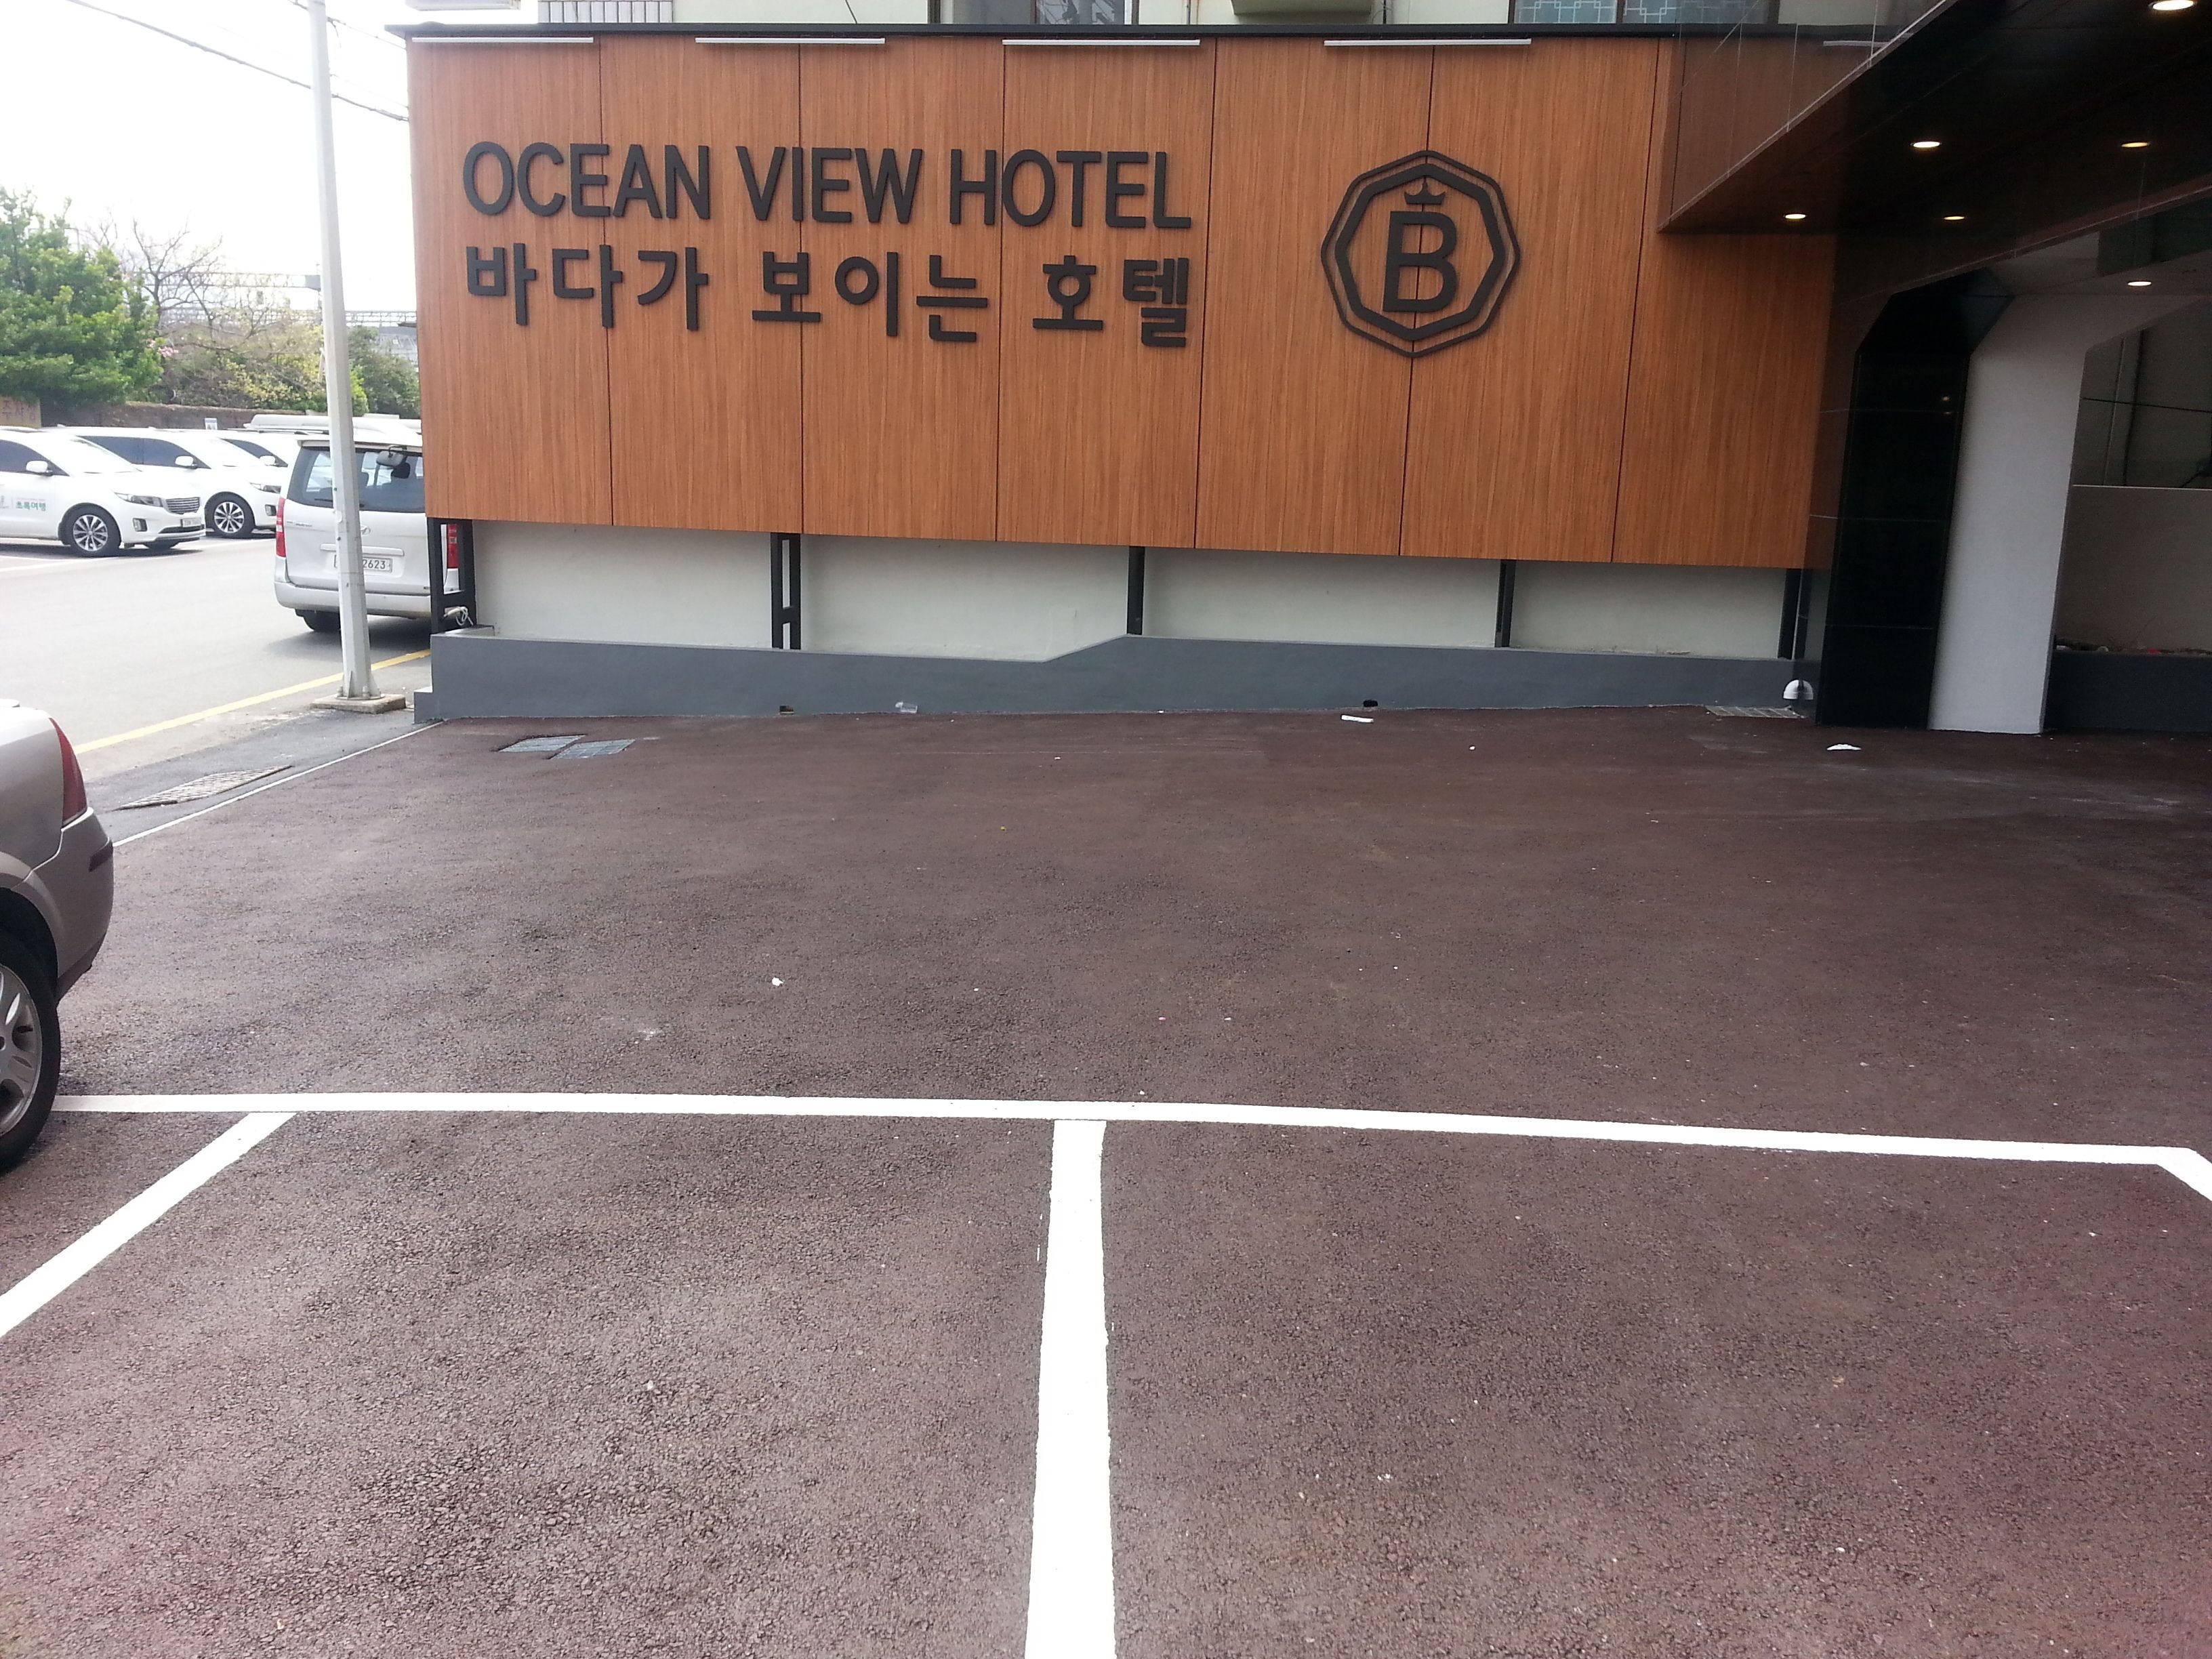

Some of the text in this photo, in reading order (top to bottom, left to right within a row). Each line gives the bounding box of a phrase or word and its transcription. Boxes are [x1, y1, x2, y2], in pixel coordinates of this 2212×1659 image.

[463, 141, 1191, 229] OCEAN VIEW HOTEL
[466, 243, 1189, 347] 바다가 보이는 호텔
[1382, 211, 1458, 312] B
[363, 559, 386, 569] 2623
